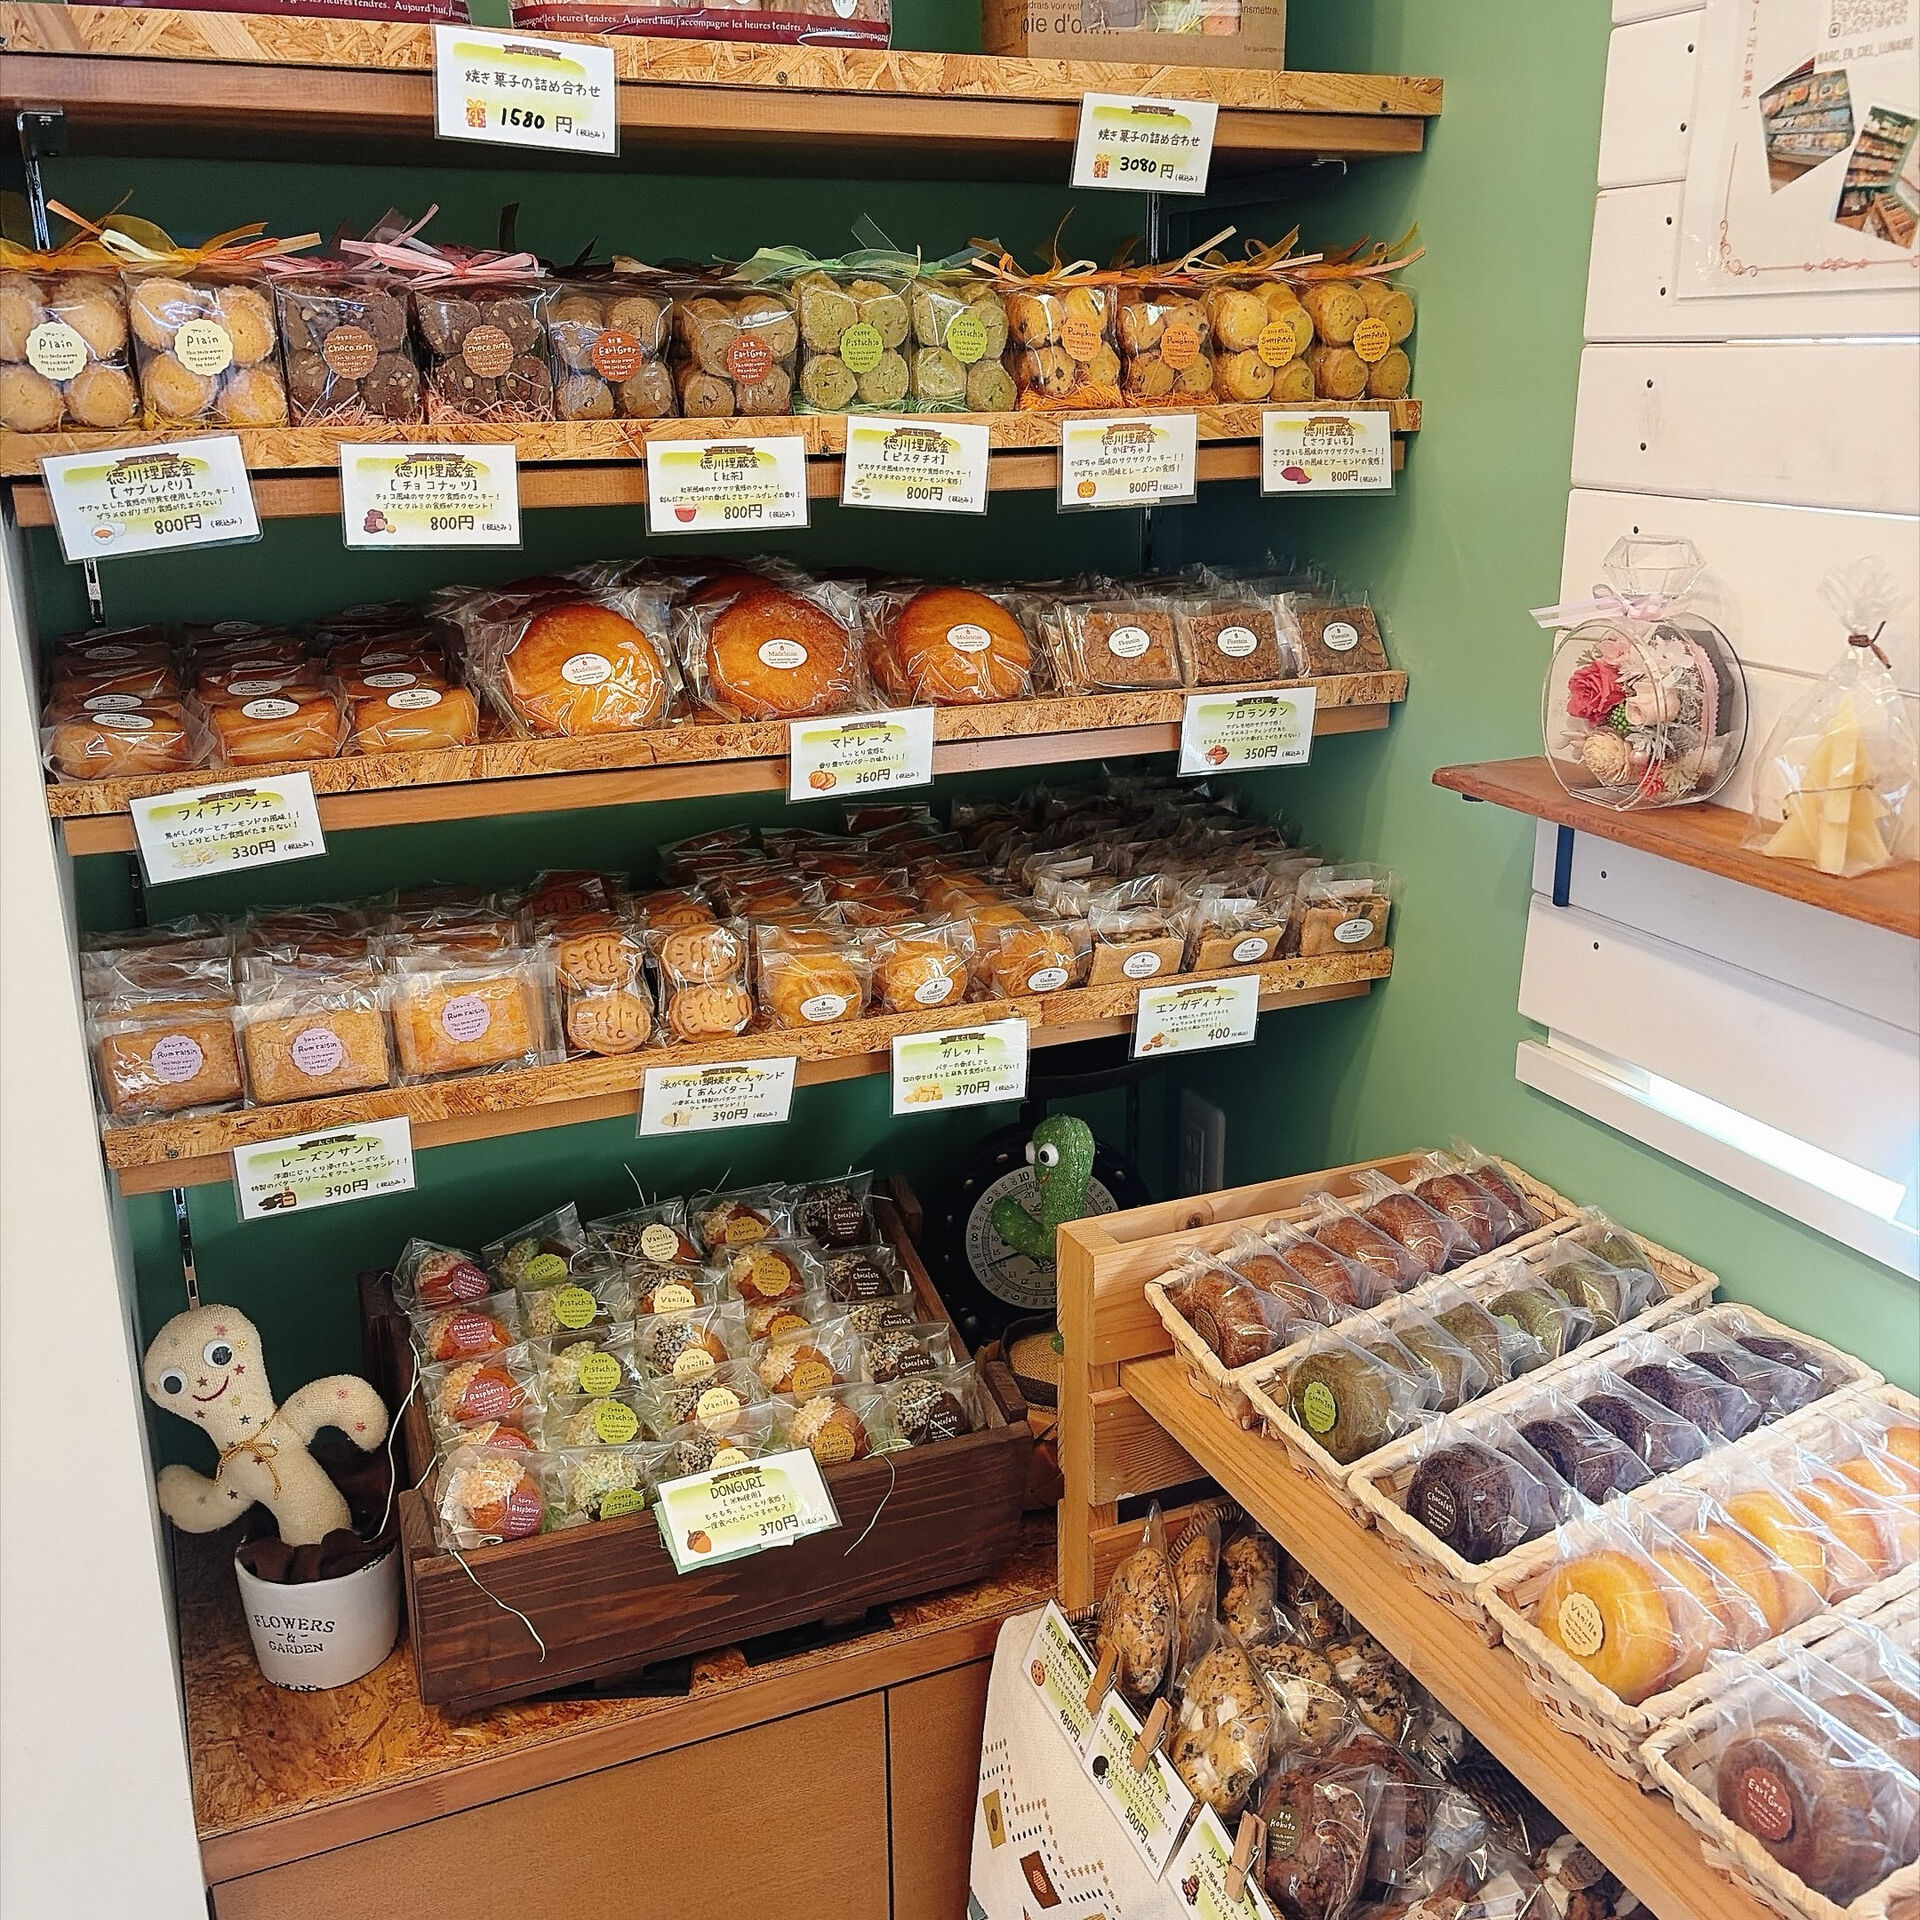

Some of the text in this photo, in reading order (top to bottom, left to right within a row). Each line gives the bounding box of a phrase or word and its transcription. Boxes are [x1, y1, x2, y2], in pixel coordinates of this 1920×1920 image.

[557, 13, 584, 24] heures
[585, 13, 619, 24] tendres.
[731, 20, 742, 29] les
[745, 21, 771, 30] heures
[772, 22, 803, 33] tendres.
[465, 69, 601, 98] 焼き菓子の詰め合わせ
[499, 107, 545, 130] 1580
[555, 116, 572, 134] 円
[1098, 130, 1200, 148] 焼き菓子の詰め合わせ
[1119, 156, 1158, 174] 3080
[1160, 164, 1174, 179] 円
[39, 338, 72, 351] Plain
[187, 336, 219, 348] Plain
[884, 436, 952, 454] 徳川埋蔵金
[1101, 430, 1158, 446] 徳川埋蔵金
[1302, 437, 1354, 446] 【さつまいも】
[1104, 445, 1151, 455] 【かぼちゃ】
[700, 456, 761, 470] 徳川埋蔵金
[883, 452, 945, 465] 【ピスタチオ】
[105, 460, 196, 486] 徳川埋蔵金
[394, 463, 478, 479] 徳川埋蔵金
[713, 471, 743, 481] 【紅茶】
[1331, 470, 1358, 482] 800円
[110, 478, 193, 500] 【サブレパリ】
[390, 480, 479, 491] 【チョコナッツ】
[1129, 480, 1158, 494] 800円
[907, 486, 943, 501] 800円
[724, 504, 763, 519] 800円
[154, 514, 202, 535] 800円
[430, 515, 474, 531] 800円
[1226, 707, 1288, 720] フロランタン
[830, 733, 893, 749] マドレーヌ
[1244, 745, 1278, 760] 350円
[855, 768, 891, 784] 360円
[178, 798, 272, 821] フィナンシェ
[231, 839, 276, 860] 330円
[1156, 996, 1235, 1014] エンガディナー
[1208, 1027, 1230, 1040] 400
[942, 1044, 985, 1059] ガレット
[687, 1083, 754, 1098] 【あんバター】
[955, 1081, 990, 1096] 370円
[712, 1108, 748, 1122] 390円
[281, 1141, 379, 1168] レーズンサンド
[1018, 1171, 1029, 1180] 10
[325, 1179, 368, 1198] 390円
[985, 1196, 993, 1204] 9
[645, 1234, 673, 1244] Vanilla
[972, 1233, 978, 1241] 8
[852, 1272, 880, 1280] Chocolate
[660, 1296, 690, 1304] Vanilla
[453, 1321, 488, 1332] Raspberry
[703, 1399, 734, 1410] Vanilla
[710, 1475, 766, 1499] DONGURI
[1426, 1491, 1455, 1515] Chocolate
[758, 1514, 799, 1536] 370円
[254, 1614, 335, 1632] FLOWERS
[1570, 1603, 1597, 1637] Vanilla
[268, 1640, 323, 1654] GARDEN
[1059, 1709, 1081, 1743] 480円
[1124, 1806, 1149, 1844] 500円
